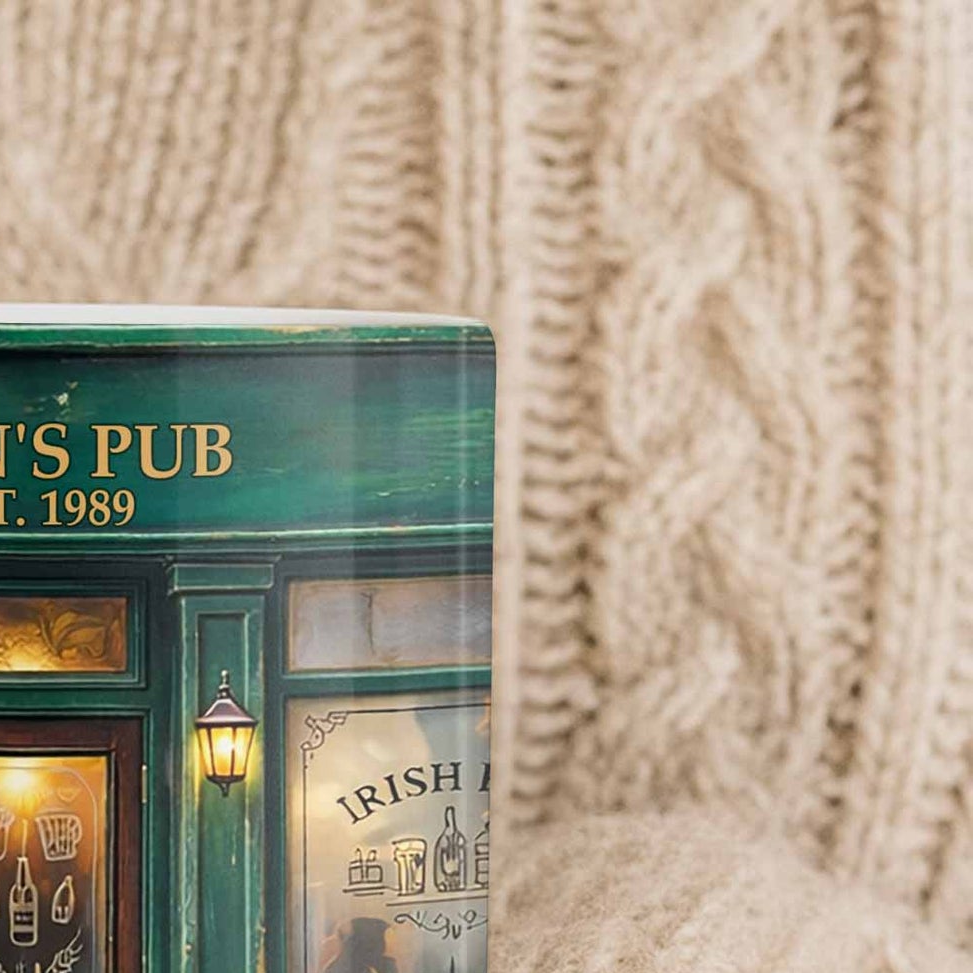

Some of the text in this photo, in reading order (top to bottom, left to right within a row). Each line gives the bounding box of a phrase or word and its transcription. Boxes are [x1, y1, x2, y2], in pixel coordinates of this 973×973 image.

[90, 422, 234, 480] PUB
[40, 488, 137, 528] 1989
[336, 761, 463, 824] IRISH
